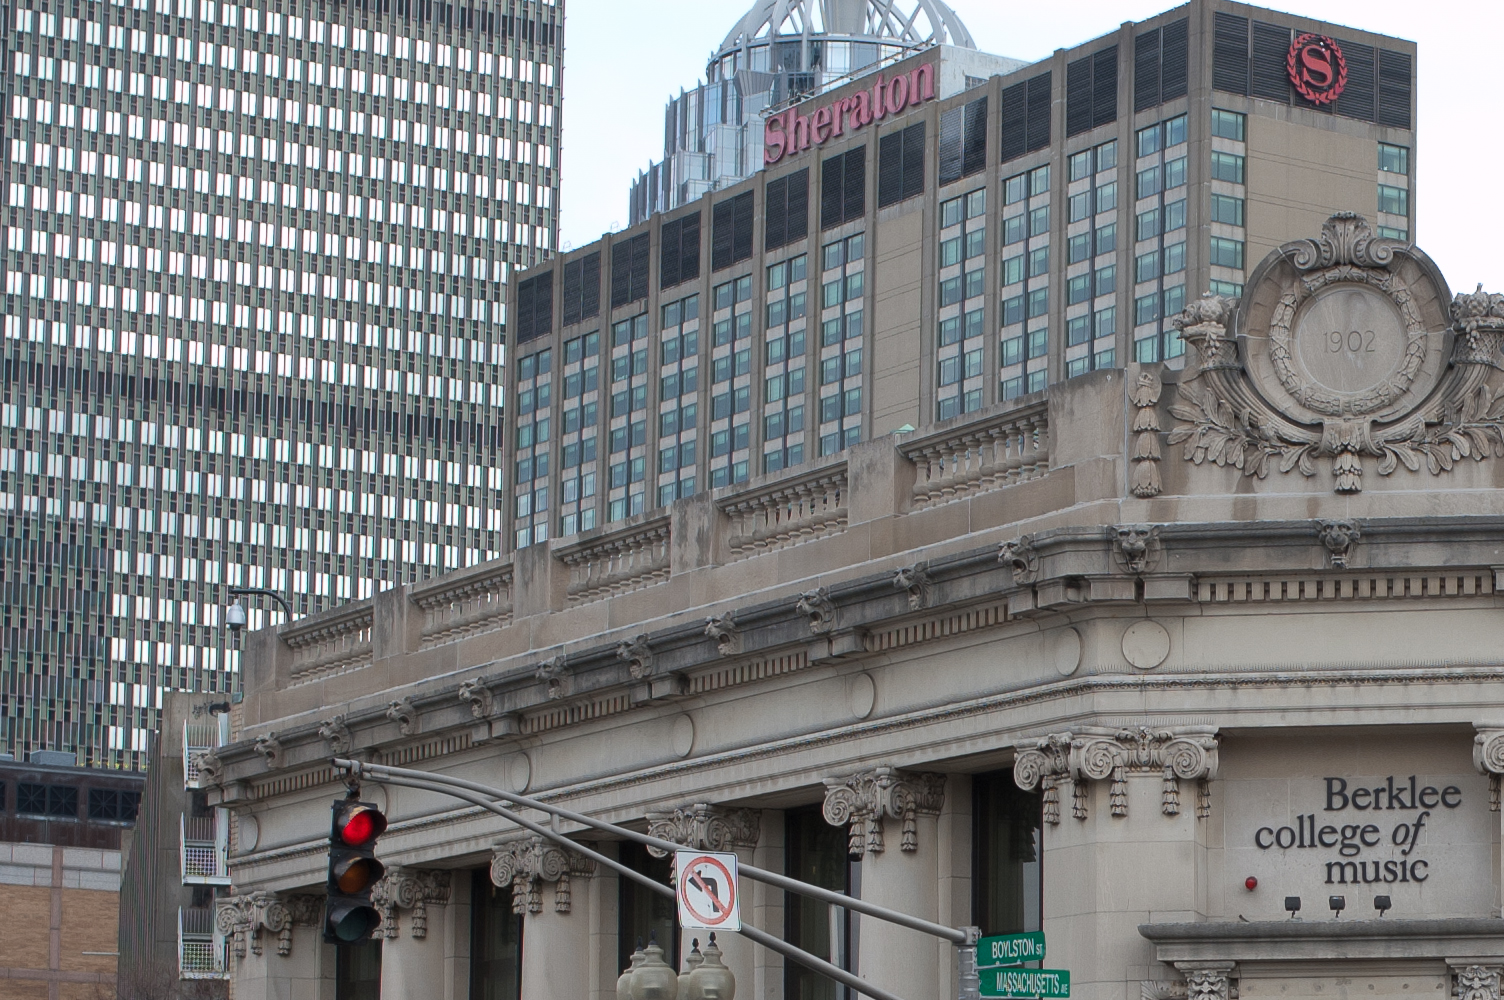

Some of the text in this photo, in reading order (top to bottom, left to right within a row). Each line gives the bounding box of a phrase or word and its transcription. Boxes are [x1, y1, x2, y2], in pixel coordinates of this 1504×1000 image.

[1301, 44, 1333, 87] S
[764, 63, 935, 165] Sheraton
[1323, 330, 1376, 354] 1902
[1323, 775, 1462, 811] Berklee
[1254, 810, 1431, 857] college of
[1324, 858, 1429, 884] music
[992, 938, 1043, 959] BOYLSTON ST
[996, 972, 1068, 995] MASSACHUSETTS AVE
